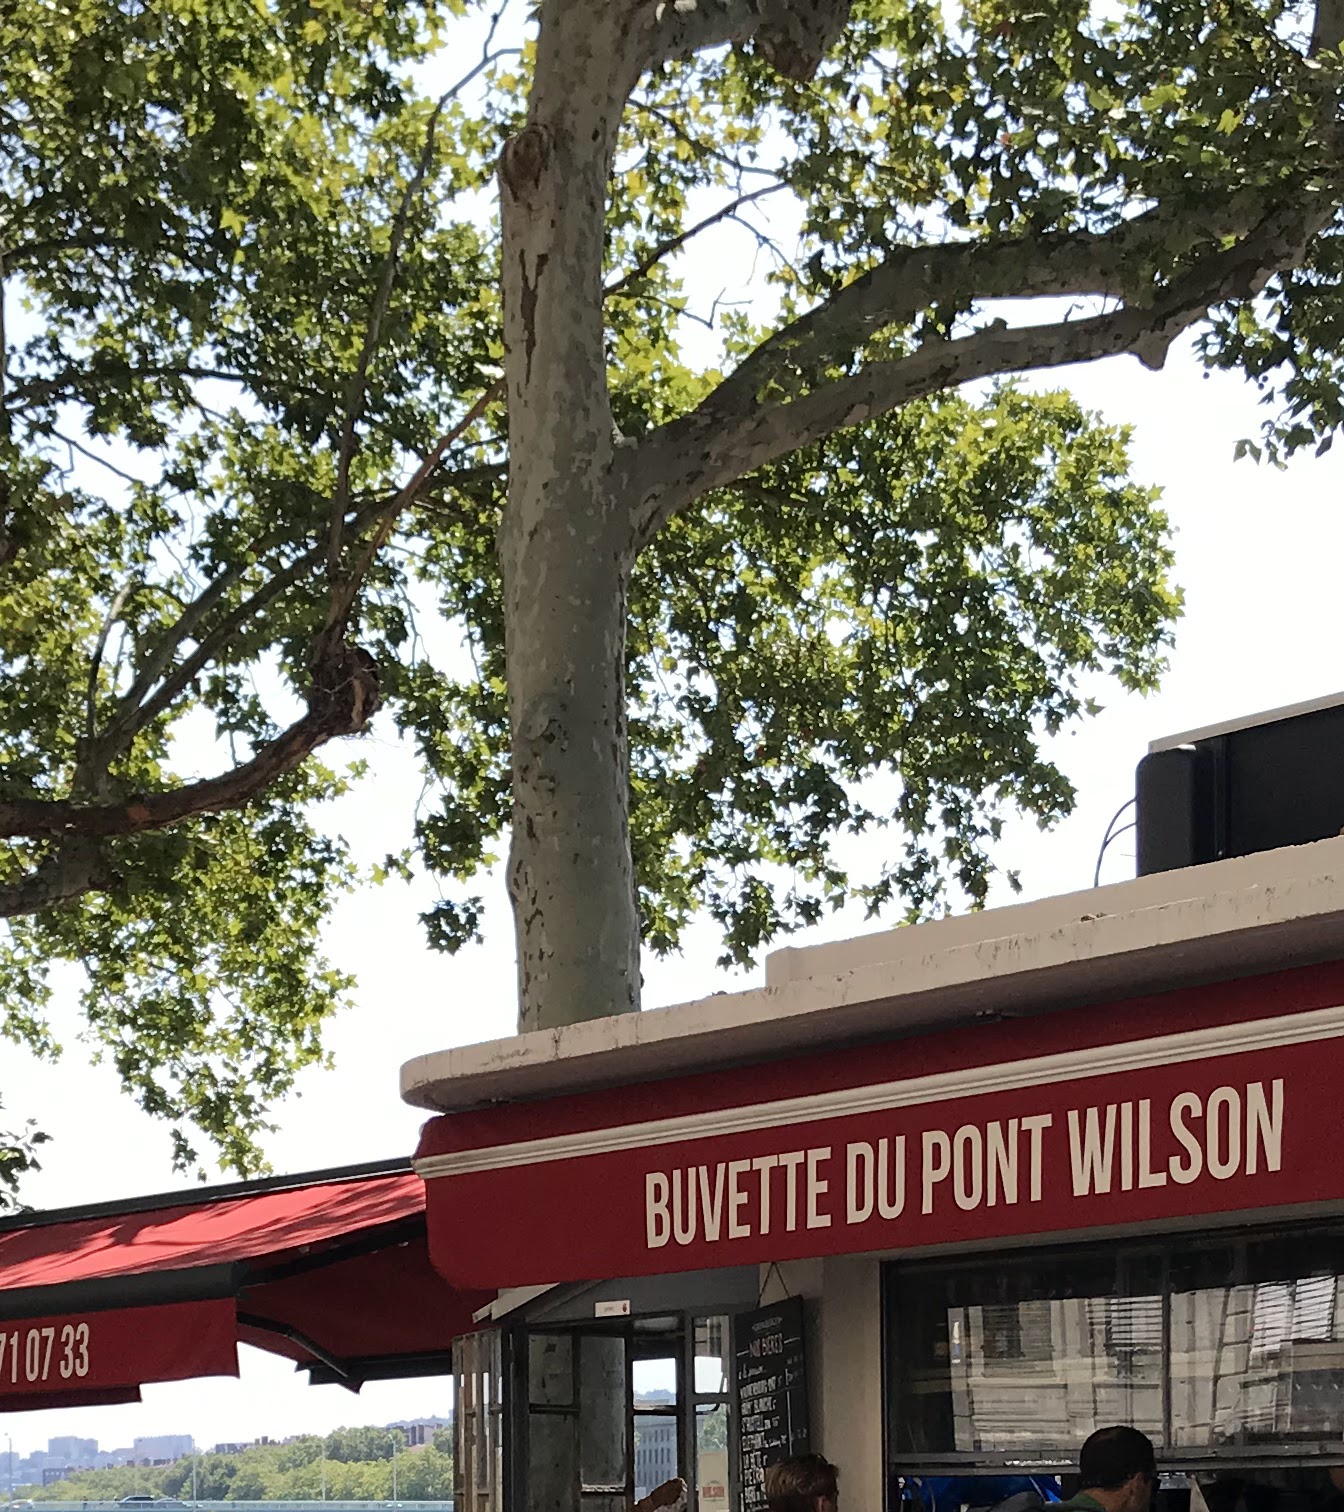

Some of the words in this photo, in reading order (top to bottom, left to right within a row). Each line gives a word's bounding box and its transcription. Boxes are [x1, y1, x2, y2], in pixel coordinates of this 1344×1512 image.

[646, 1147, 831, 1248] BUVETTE
[847, 1135, 906, 1224] DU
[921, 1114, 1052, 1214] PONT
[1067, 1078, 1284, 1196] WILSON
[25, 1326, 55, 1381] 07
[60, 1322, 89, 1378] 33
